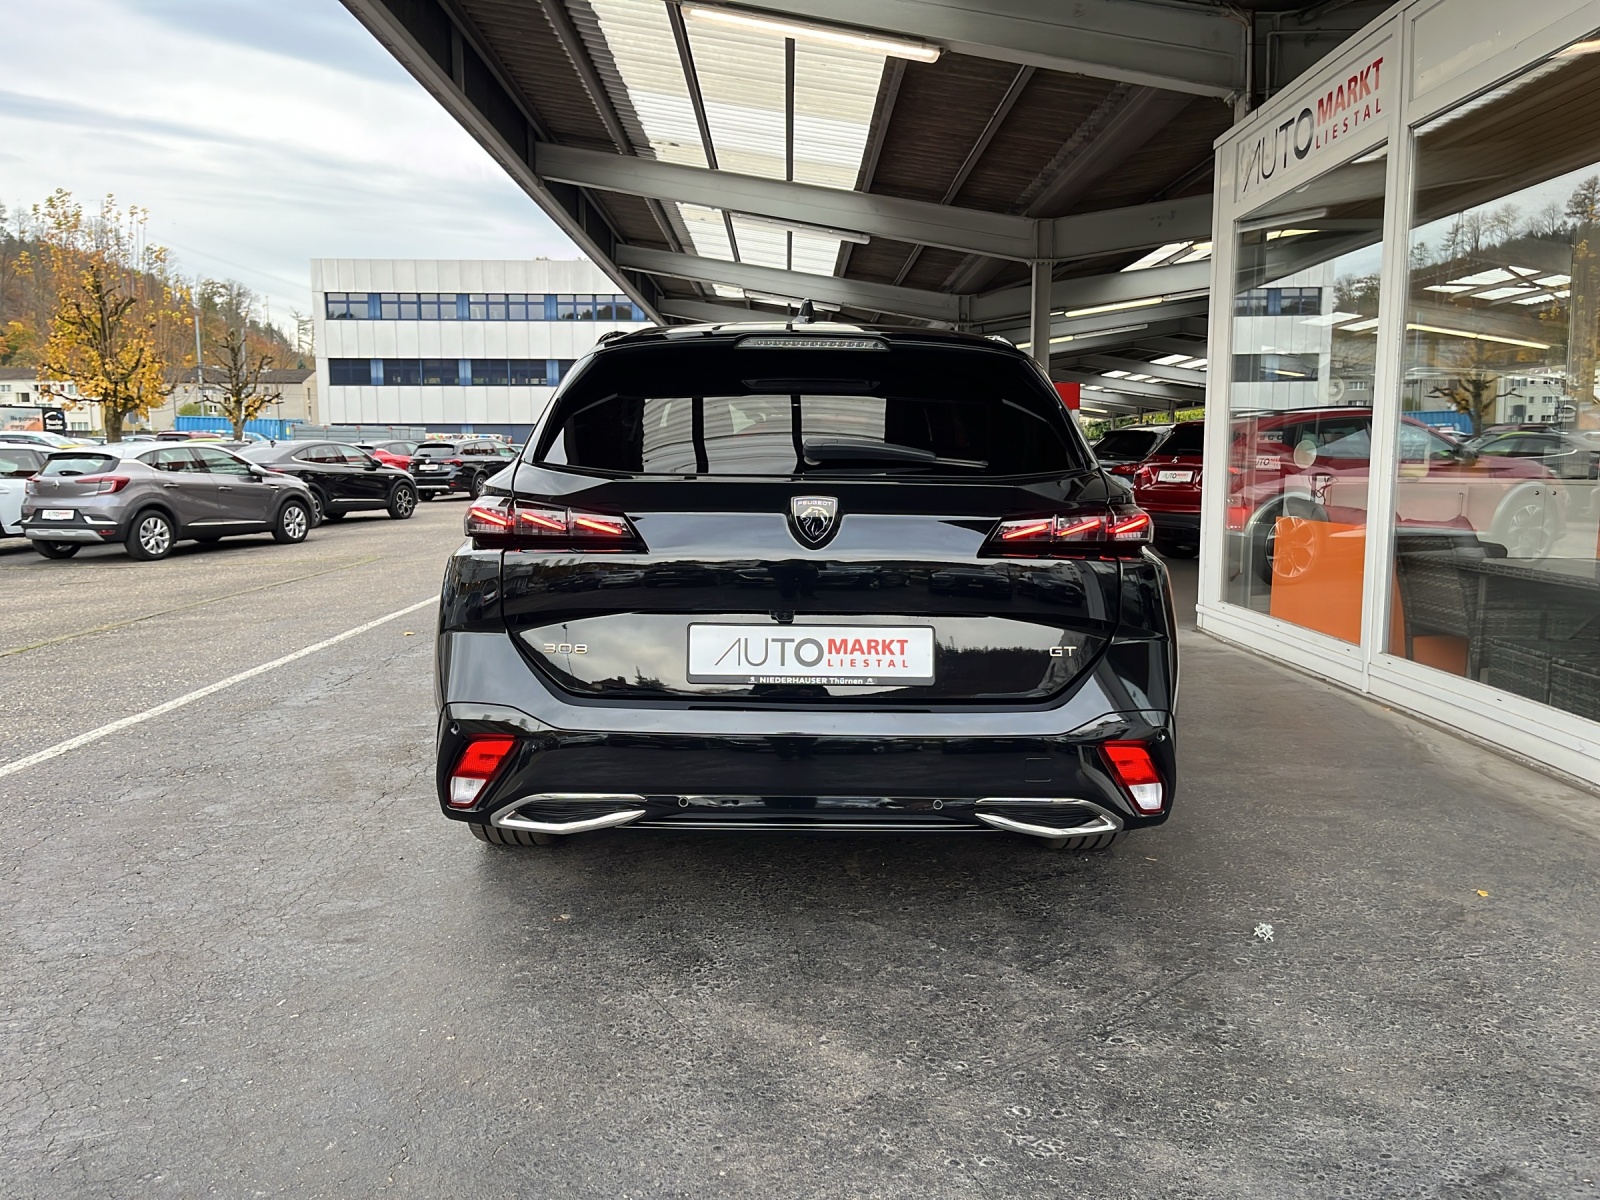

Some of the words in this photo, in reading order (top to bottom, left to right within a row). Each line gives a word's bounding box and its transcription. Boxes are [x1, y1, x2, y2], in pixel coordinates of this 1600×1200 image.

[1243, 107, 1315, 193] AUTO
[1317, 56, 1384, 127] MARKT
[1315, 98, 1382, 150] LIESTAL
[543, 643, 588, 654] 308
[714, 637, 824, 668] AUTO
[827, 638, 909, 656] MARKT
[1049, 646, 1077, 657] GT
[827, 658, 909, 668] LIESTAL
[759, 676, 828, 684] NIEDERHAUSER
[828, 677, 863, 685] Thürnen
